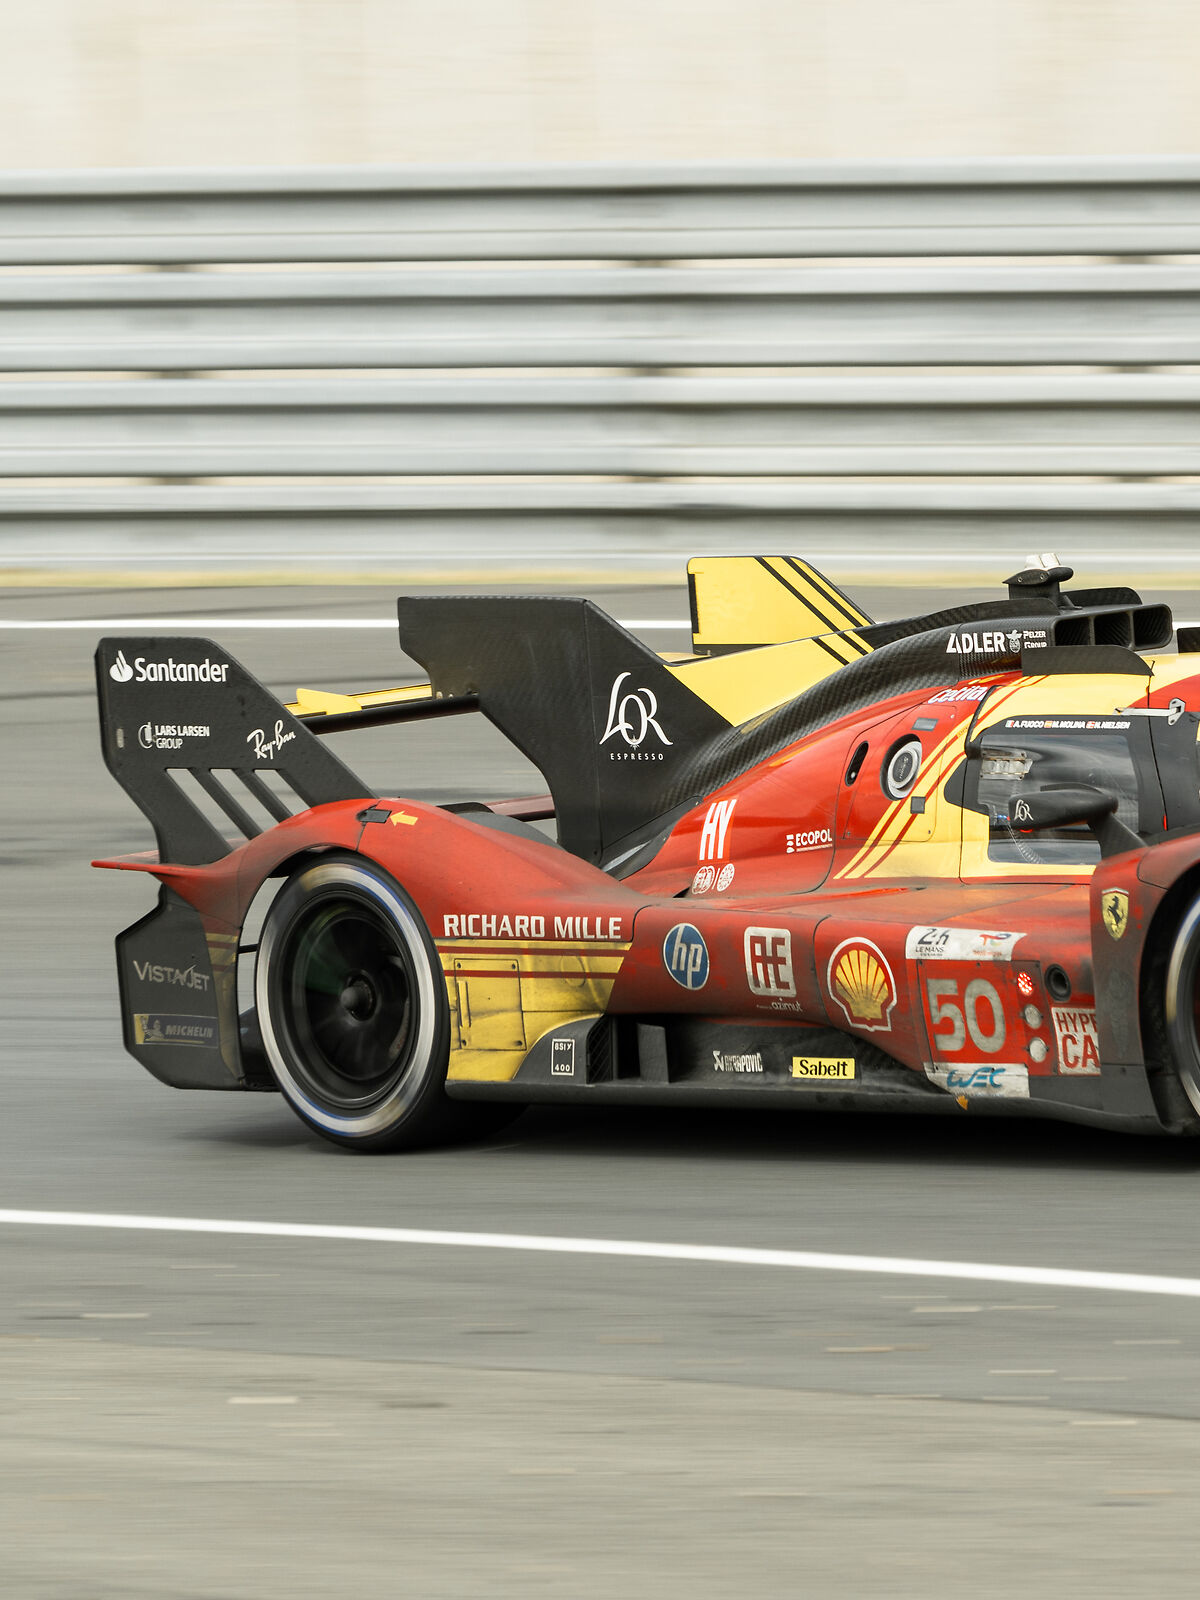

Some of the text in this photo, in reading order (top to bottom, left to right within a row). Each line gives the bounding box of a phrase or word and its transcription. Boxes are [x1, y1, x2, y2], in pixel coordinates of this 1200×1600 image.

[946, 631, 1006, 653] ADLER
[1022, 630, 1047, 639] PELZER
[134, 657, 229, 683] Santander
[154, 725, 210, 737] LARS LARSEN
[156, 738, 183, 749] GROUP
[610, 752, 664, 761] ESPRESSO
[699, 799, 737, 861] HY
[795, 828, 833, 847] ECOPOL
[443, 914, 622, 939] RICHARD MILLE
[671, 926, 707, 989] hp
[926, 978, 1006, 1053] 50
[165, 1024, 214, 1038] MICHELIN
[554, 1064, 570, 1072] 400
[799, 1059, 848, 1077] Sabelt
[946, 1066, 1006, 1089] WEC
